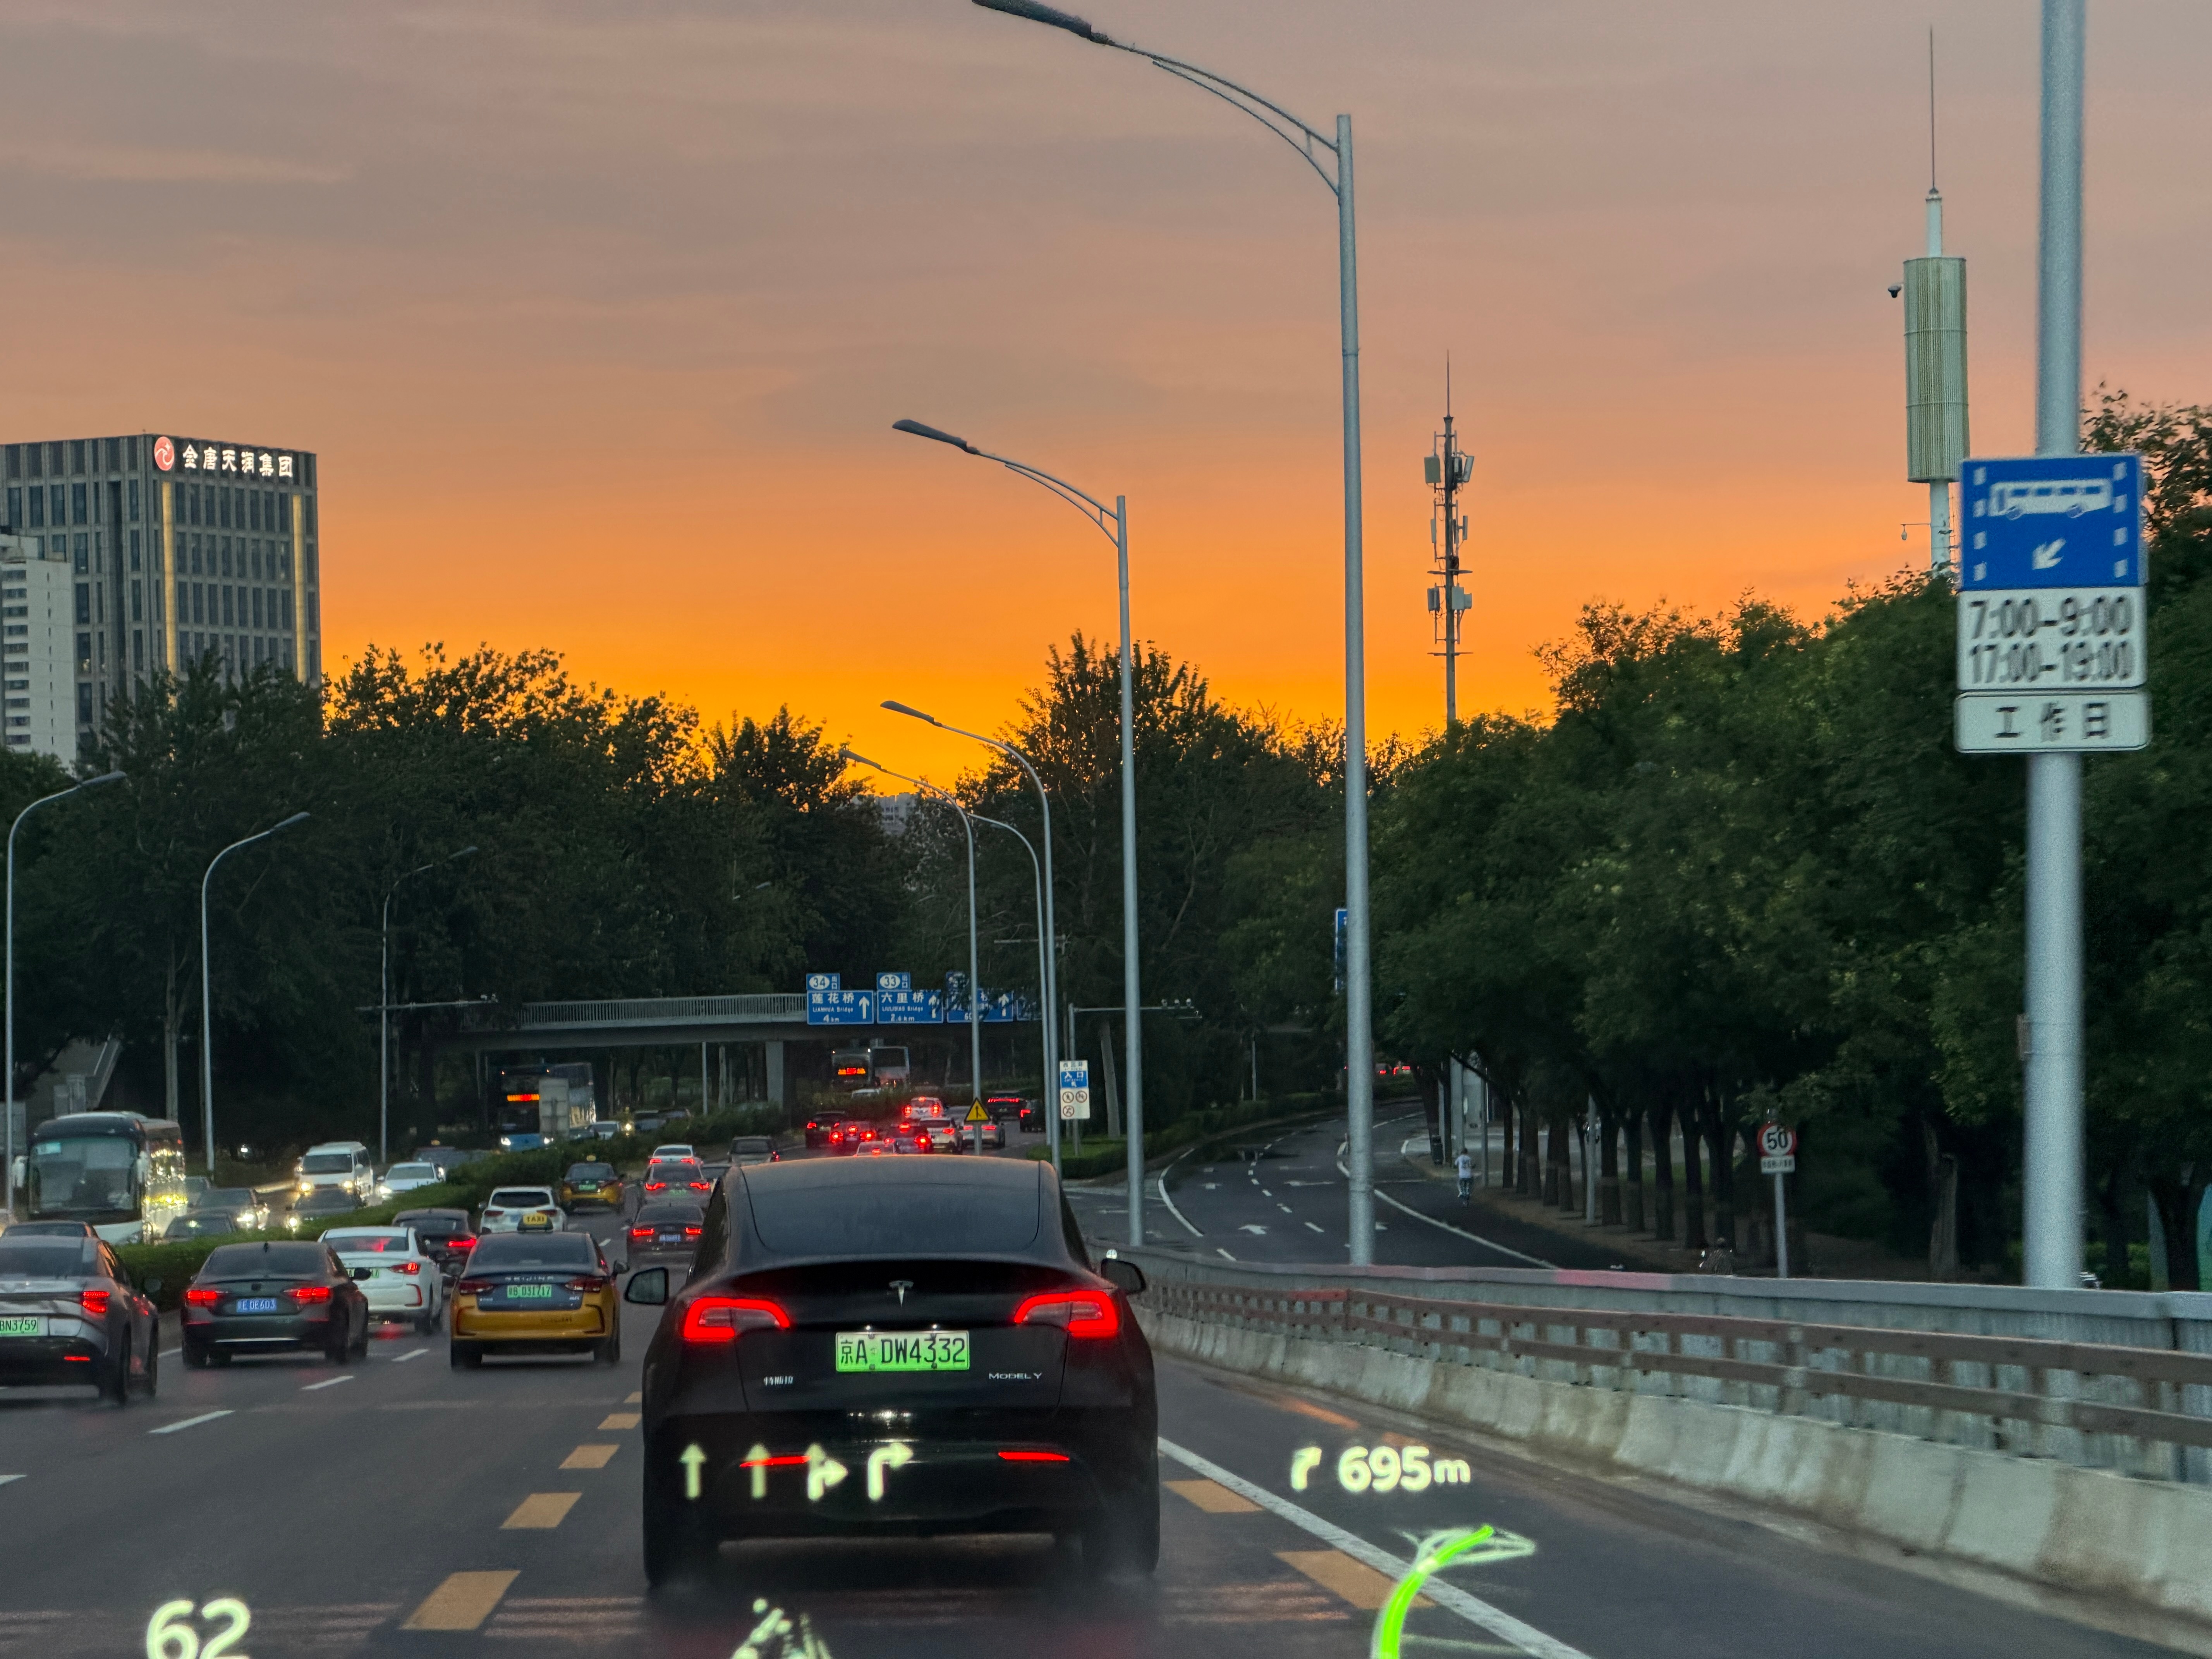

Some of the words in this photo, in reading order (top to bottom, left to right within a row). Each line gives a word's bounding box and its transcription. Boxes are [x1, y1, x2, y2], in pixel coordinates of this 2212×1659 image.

[1970, 595, 2134, 639] 7:00-9:00
[1970, 641, 2135, 684] 17:00-19:00
[1994, 702, 2111, 742] 工作日
[813, 977, 826, 987] 34
[831, 975, 838, 989] 出口
[884, 976, 896, 986] 33
[902, 974, 908, 988] 出口
[812, 992, 854, 1004] 莲花桥
[881, 992, 924, 1003] 六里桥
[1767, 1132, 1788, 1150] 50
[146, 1598, 251, 1659] 62
